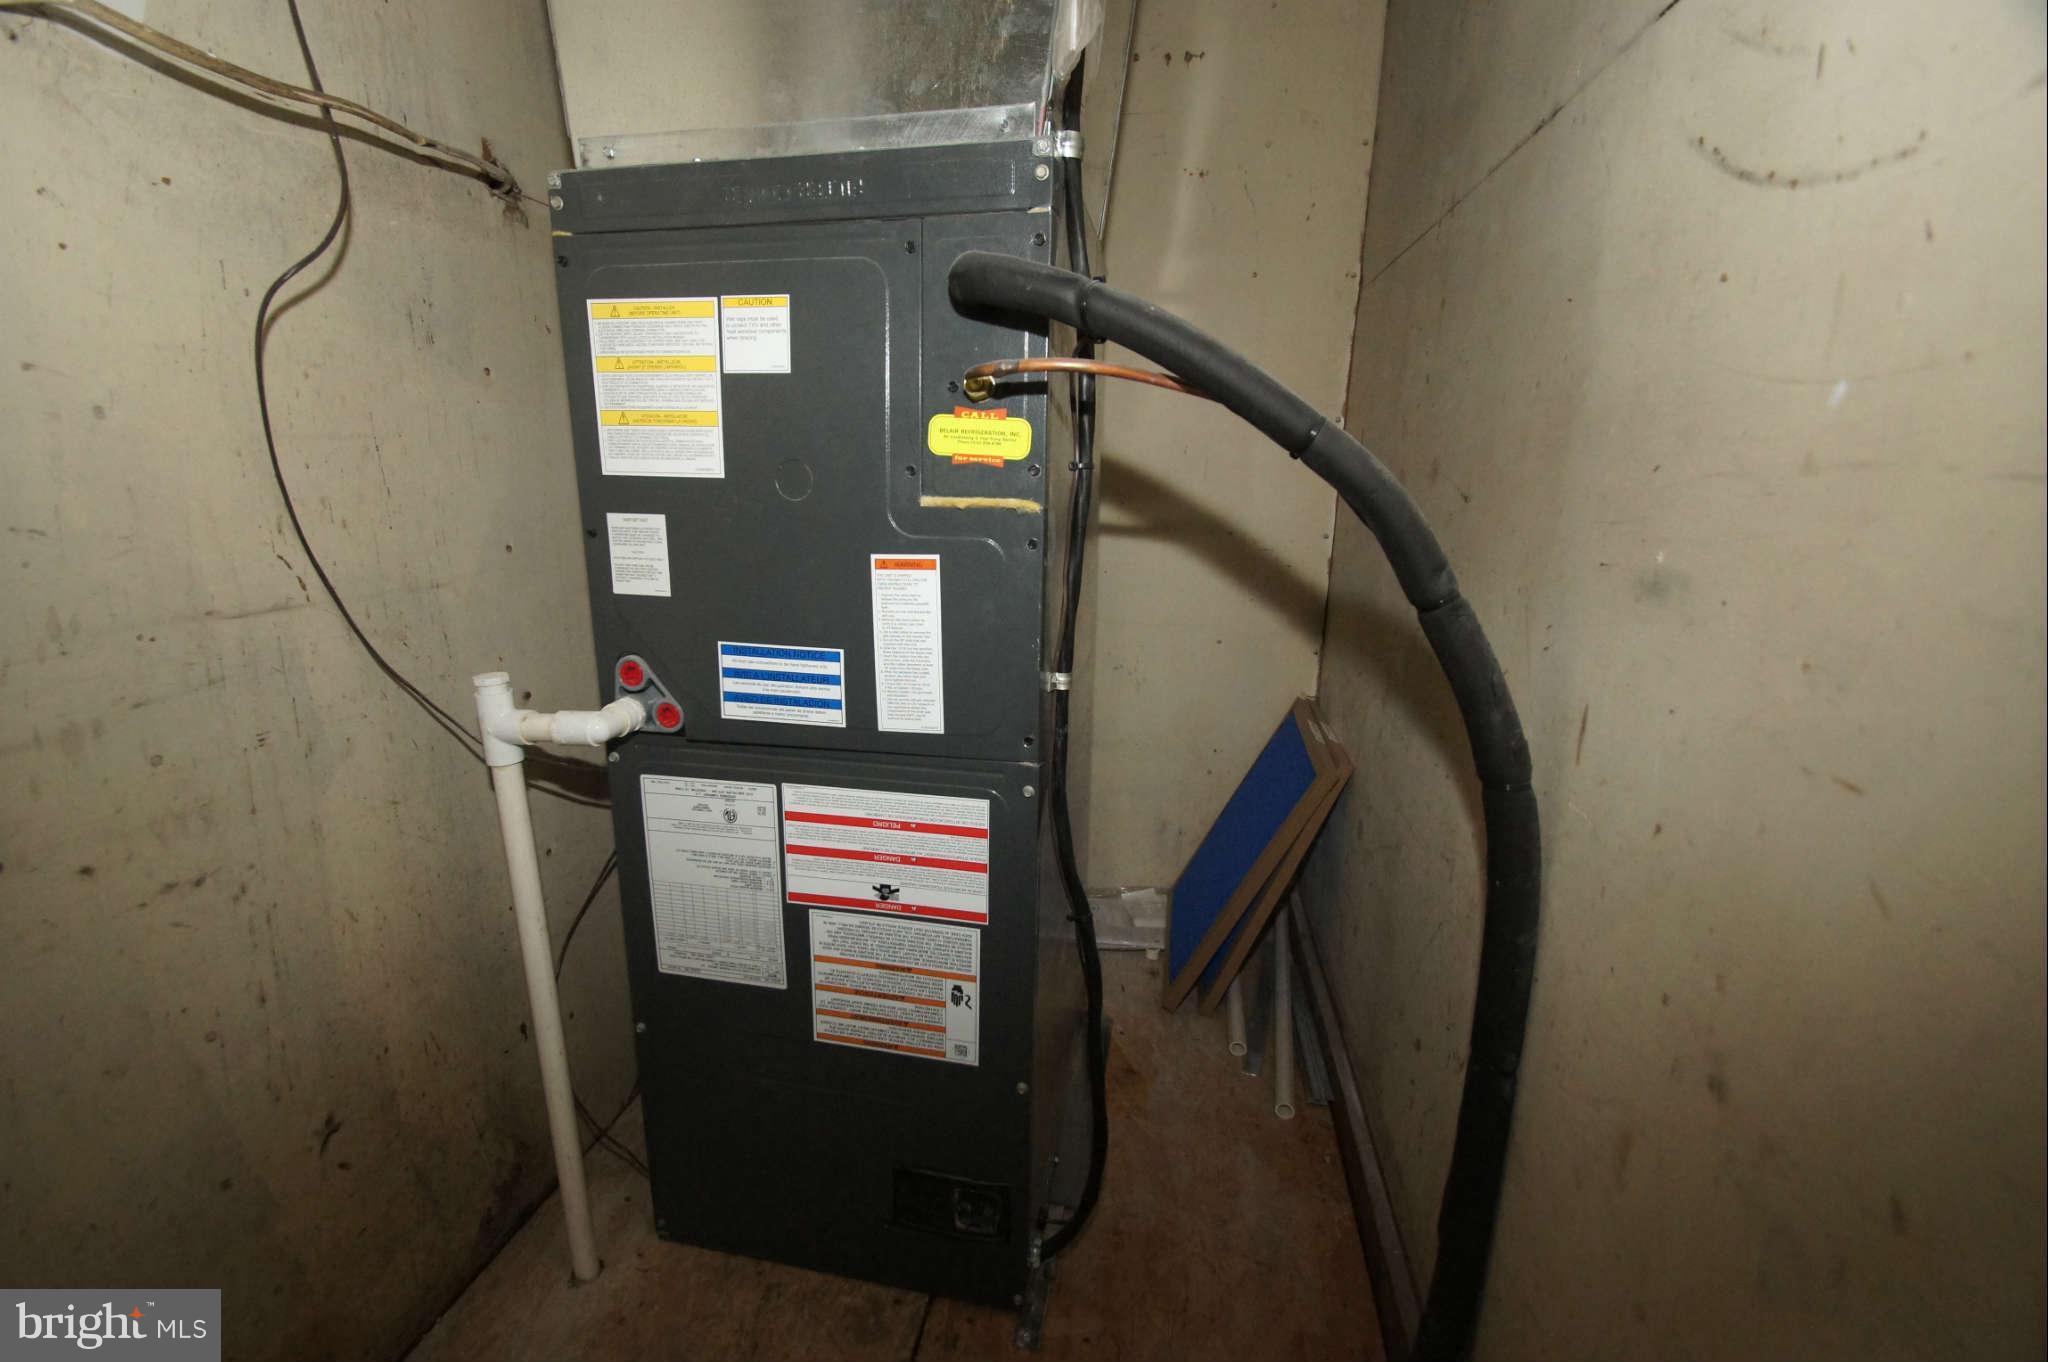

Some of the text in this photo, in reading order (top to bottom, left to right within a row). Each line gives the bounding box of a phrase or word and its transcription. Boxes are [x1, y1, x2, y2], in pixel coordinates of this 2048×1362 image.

[738, 297, 773, 306] CAUTION
[961, 411, 999, 420] CALL
[954, 454, 1001, 463] for service
[872, 820, 901, 829] PELIGRO
[873, 854, 901, 862] DANGER
[875, 903, 902, 911] DANGER
